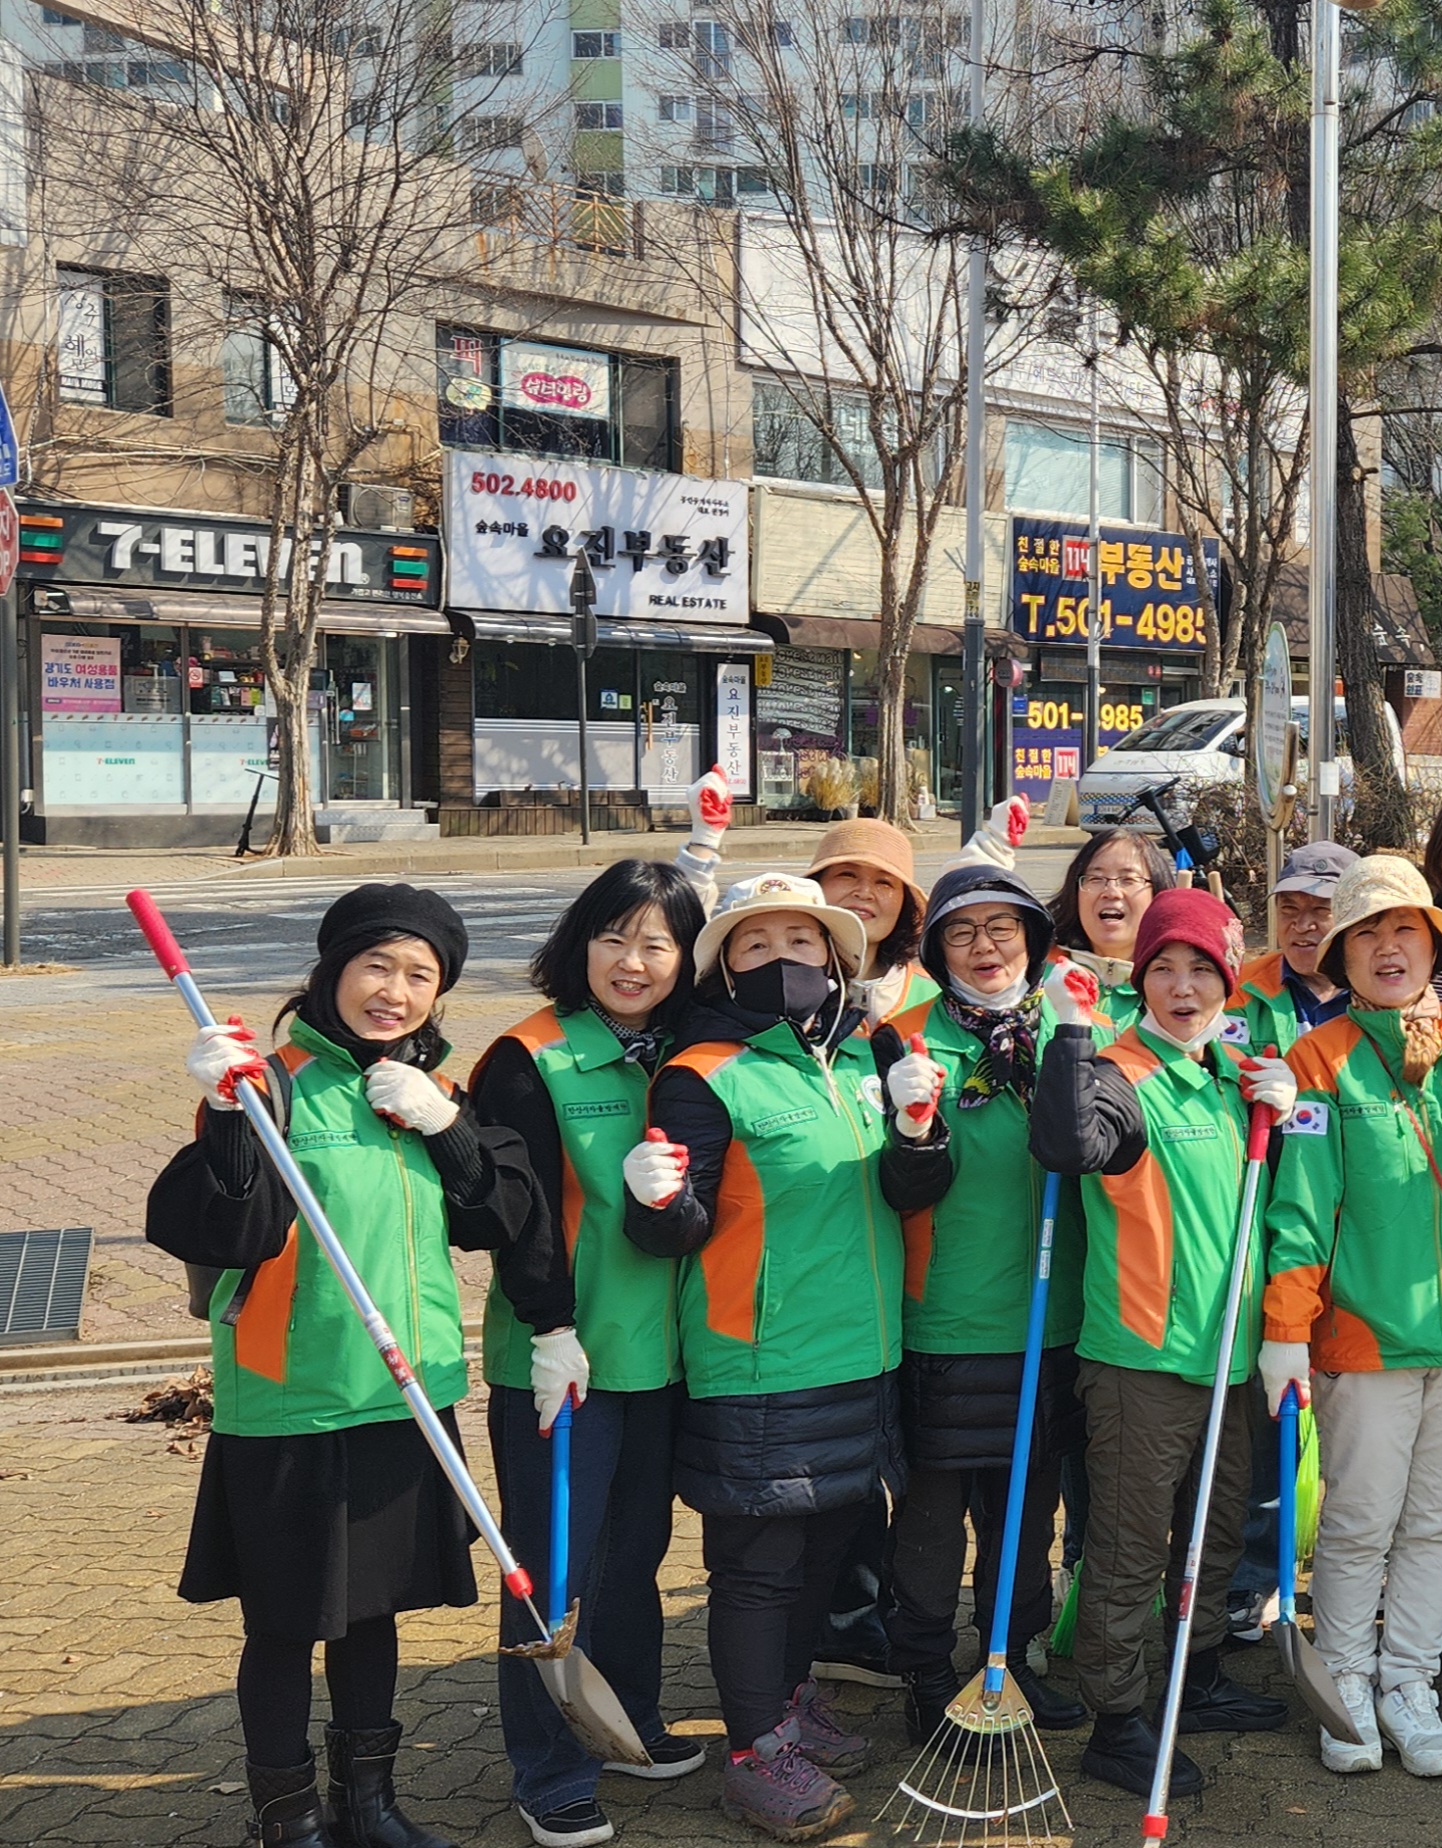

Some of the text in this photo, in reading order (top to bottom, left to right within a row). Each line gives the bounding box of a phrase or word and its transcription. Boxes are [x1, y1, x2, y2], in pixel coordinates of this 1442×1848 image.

[471, 472, 577, 502] 502.4800
[475, 520, 736, 577] 숲속마을 요진부동산
[1018, 555, 1060, 575] 숲속마을
[1100, 540, 1185, 591] 부동산
[649, 595, 727, 610] REAL ESTATE
[726, 687, 742, 776] 요진부동산
[1028, 701, 1145, 732] 501-985
